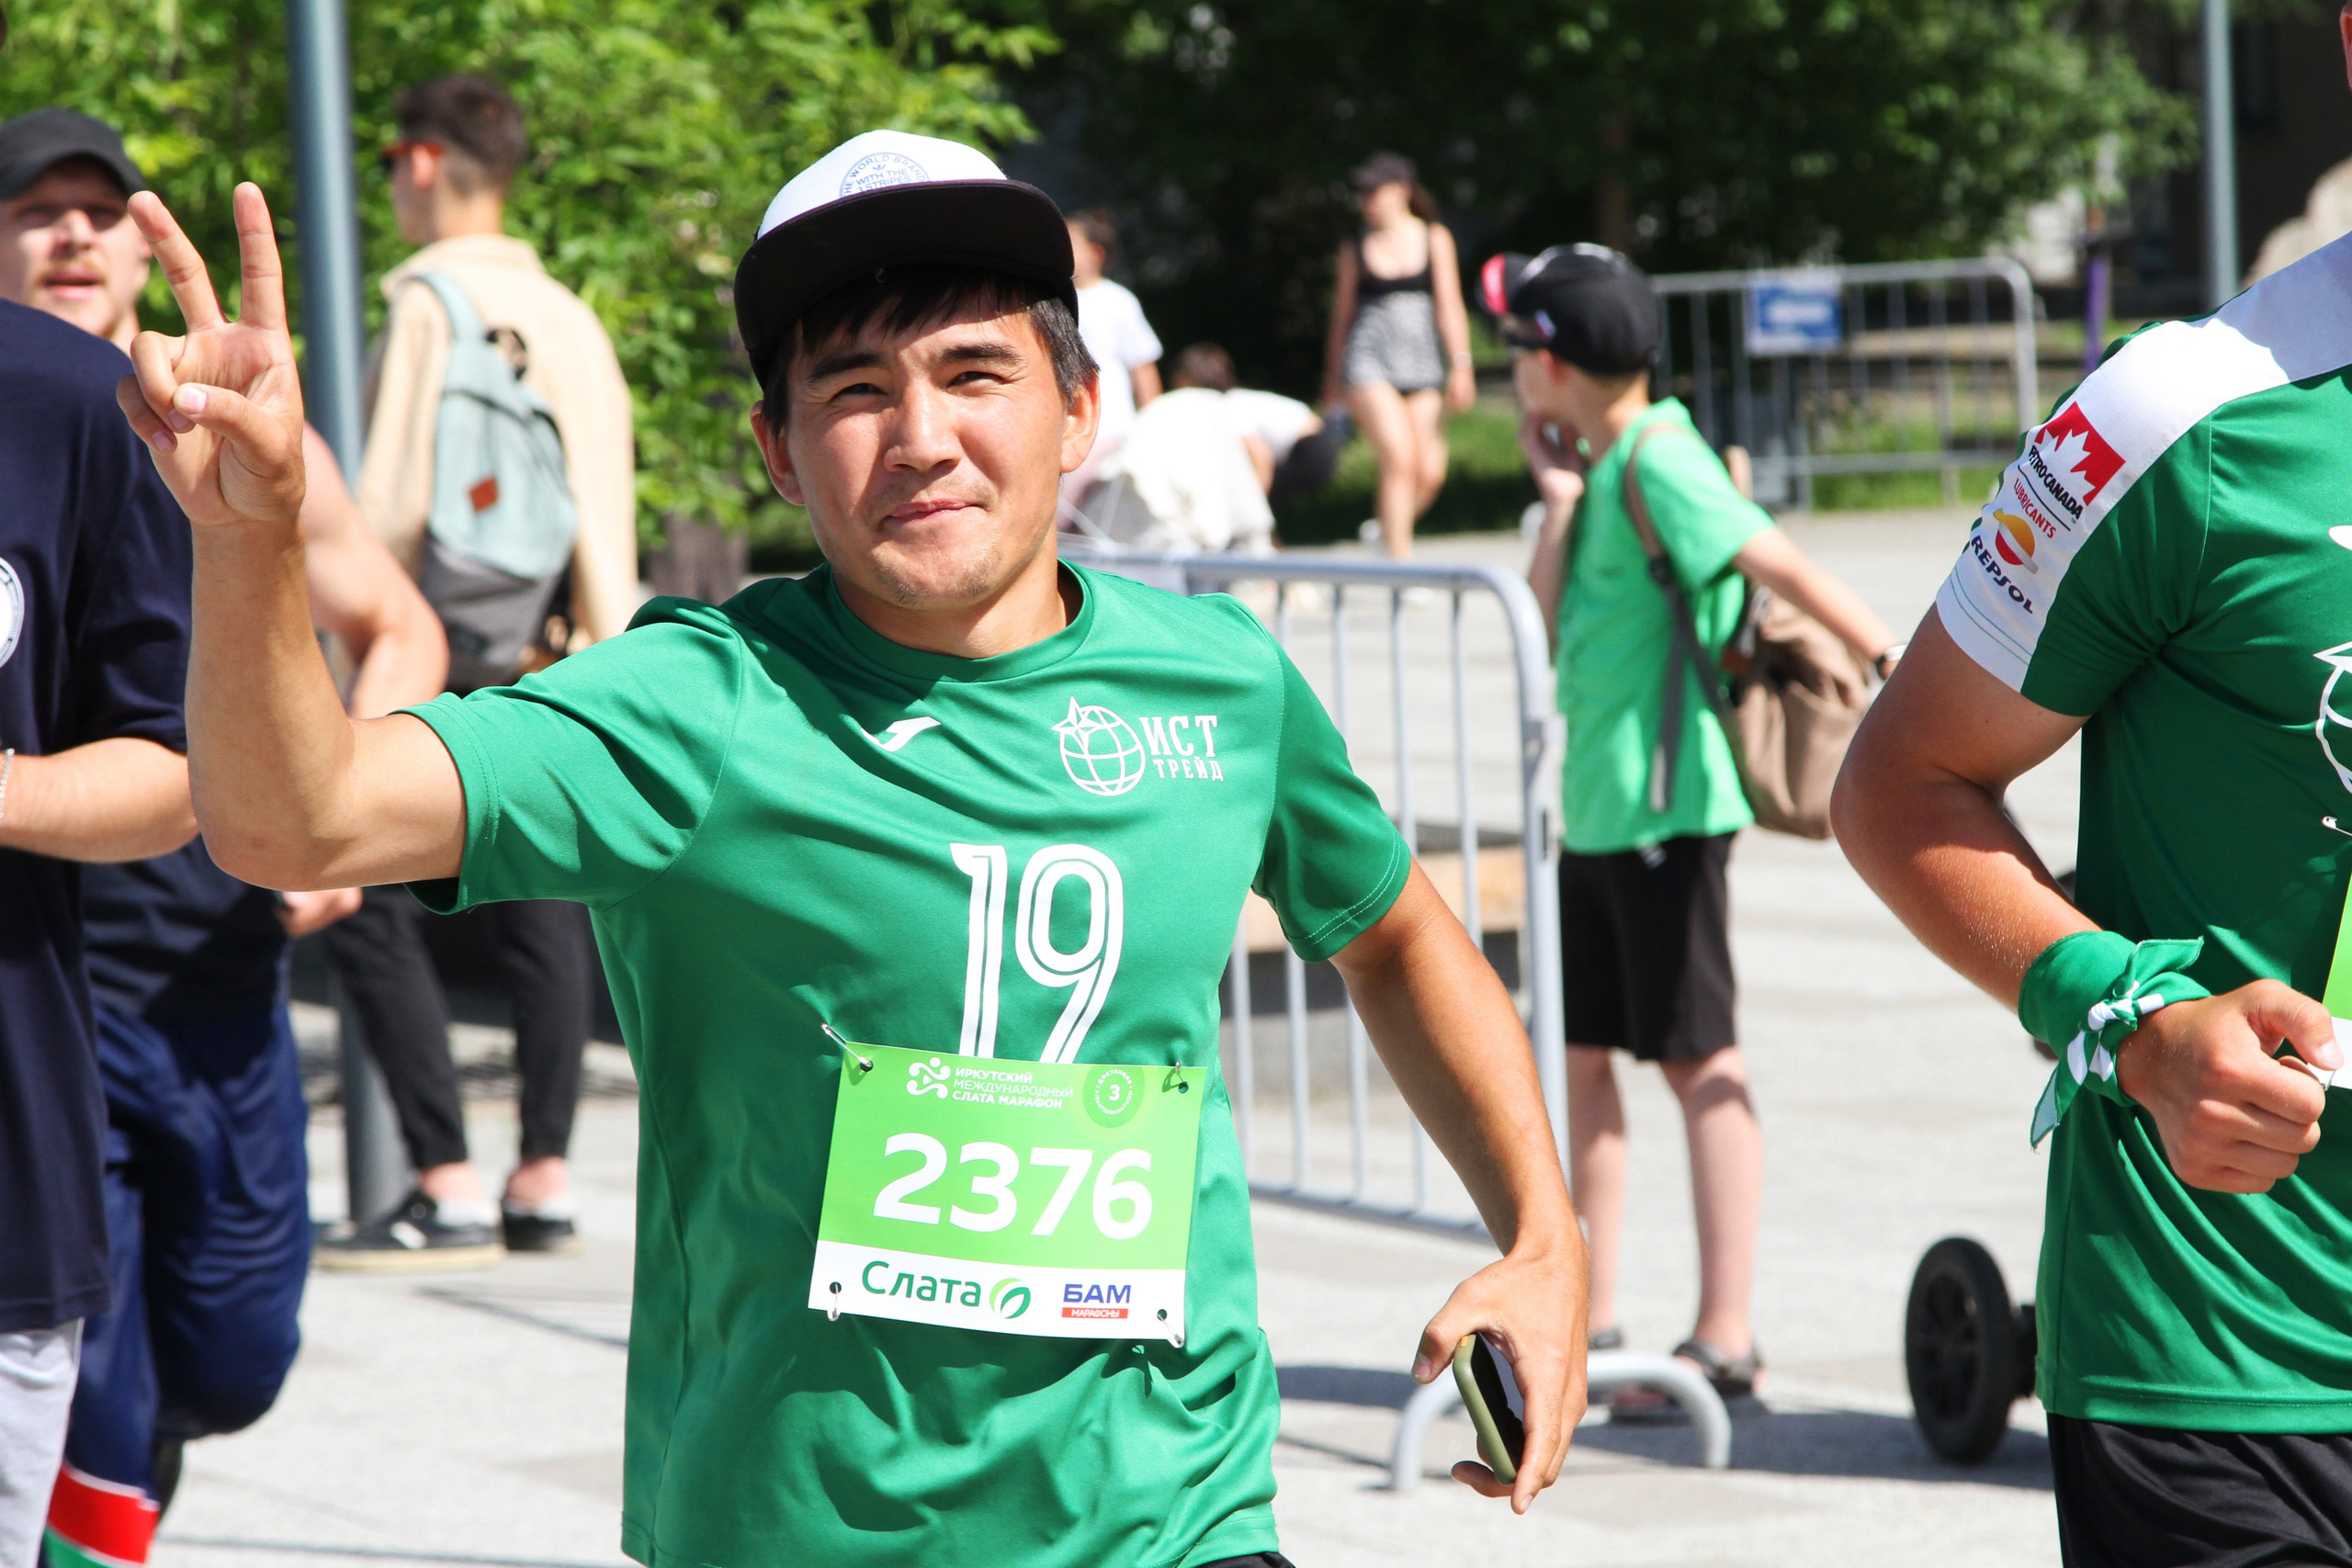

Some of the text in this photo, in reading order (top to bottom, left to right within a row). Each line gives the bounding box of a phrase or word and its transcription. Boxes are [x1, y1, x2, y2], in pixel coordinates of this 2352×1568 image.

[843, 155, 925, 197] HE WORLD BRAND
[855, 168, 908, 186] WITH THE
[865, 175, 910, 189] STRIPES
[2014, 478, 2056, 537] LUBRICANTS
[1972, 536, 2032, 614] REPSOL
[1139, 715, 1218, 758] ИСТ
[1152, 756, 1224, 782] ТРЕЙД
[950, 842, 1124, 1064] 19
[955, 1066, 1033, 1084] ИРКУТСКИЙ
[952, 1090, 1062, 1110] СЛАТА МАРАФОН
[953, 1079, 1073, 1098] МЕЖДУНАРОДНЫЙ
[1109, 1084, 1121, 1101] 3
[873, 1132, 1153, 1240] 2376
[862, 1260, 981, 1307] Слата
[1063, 1283, 1131, 1304] БАМ
[1071, 1308, 1120, 1318] МАРАФОНЫ
